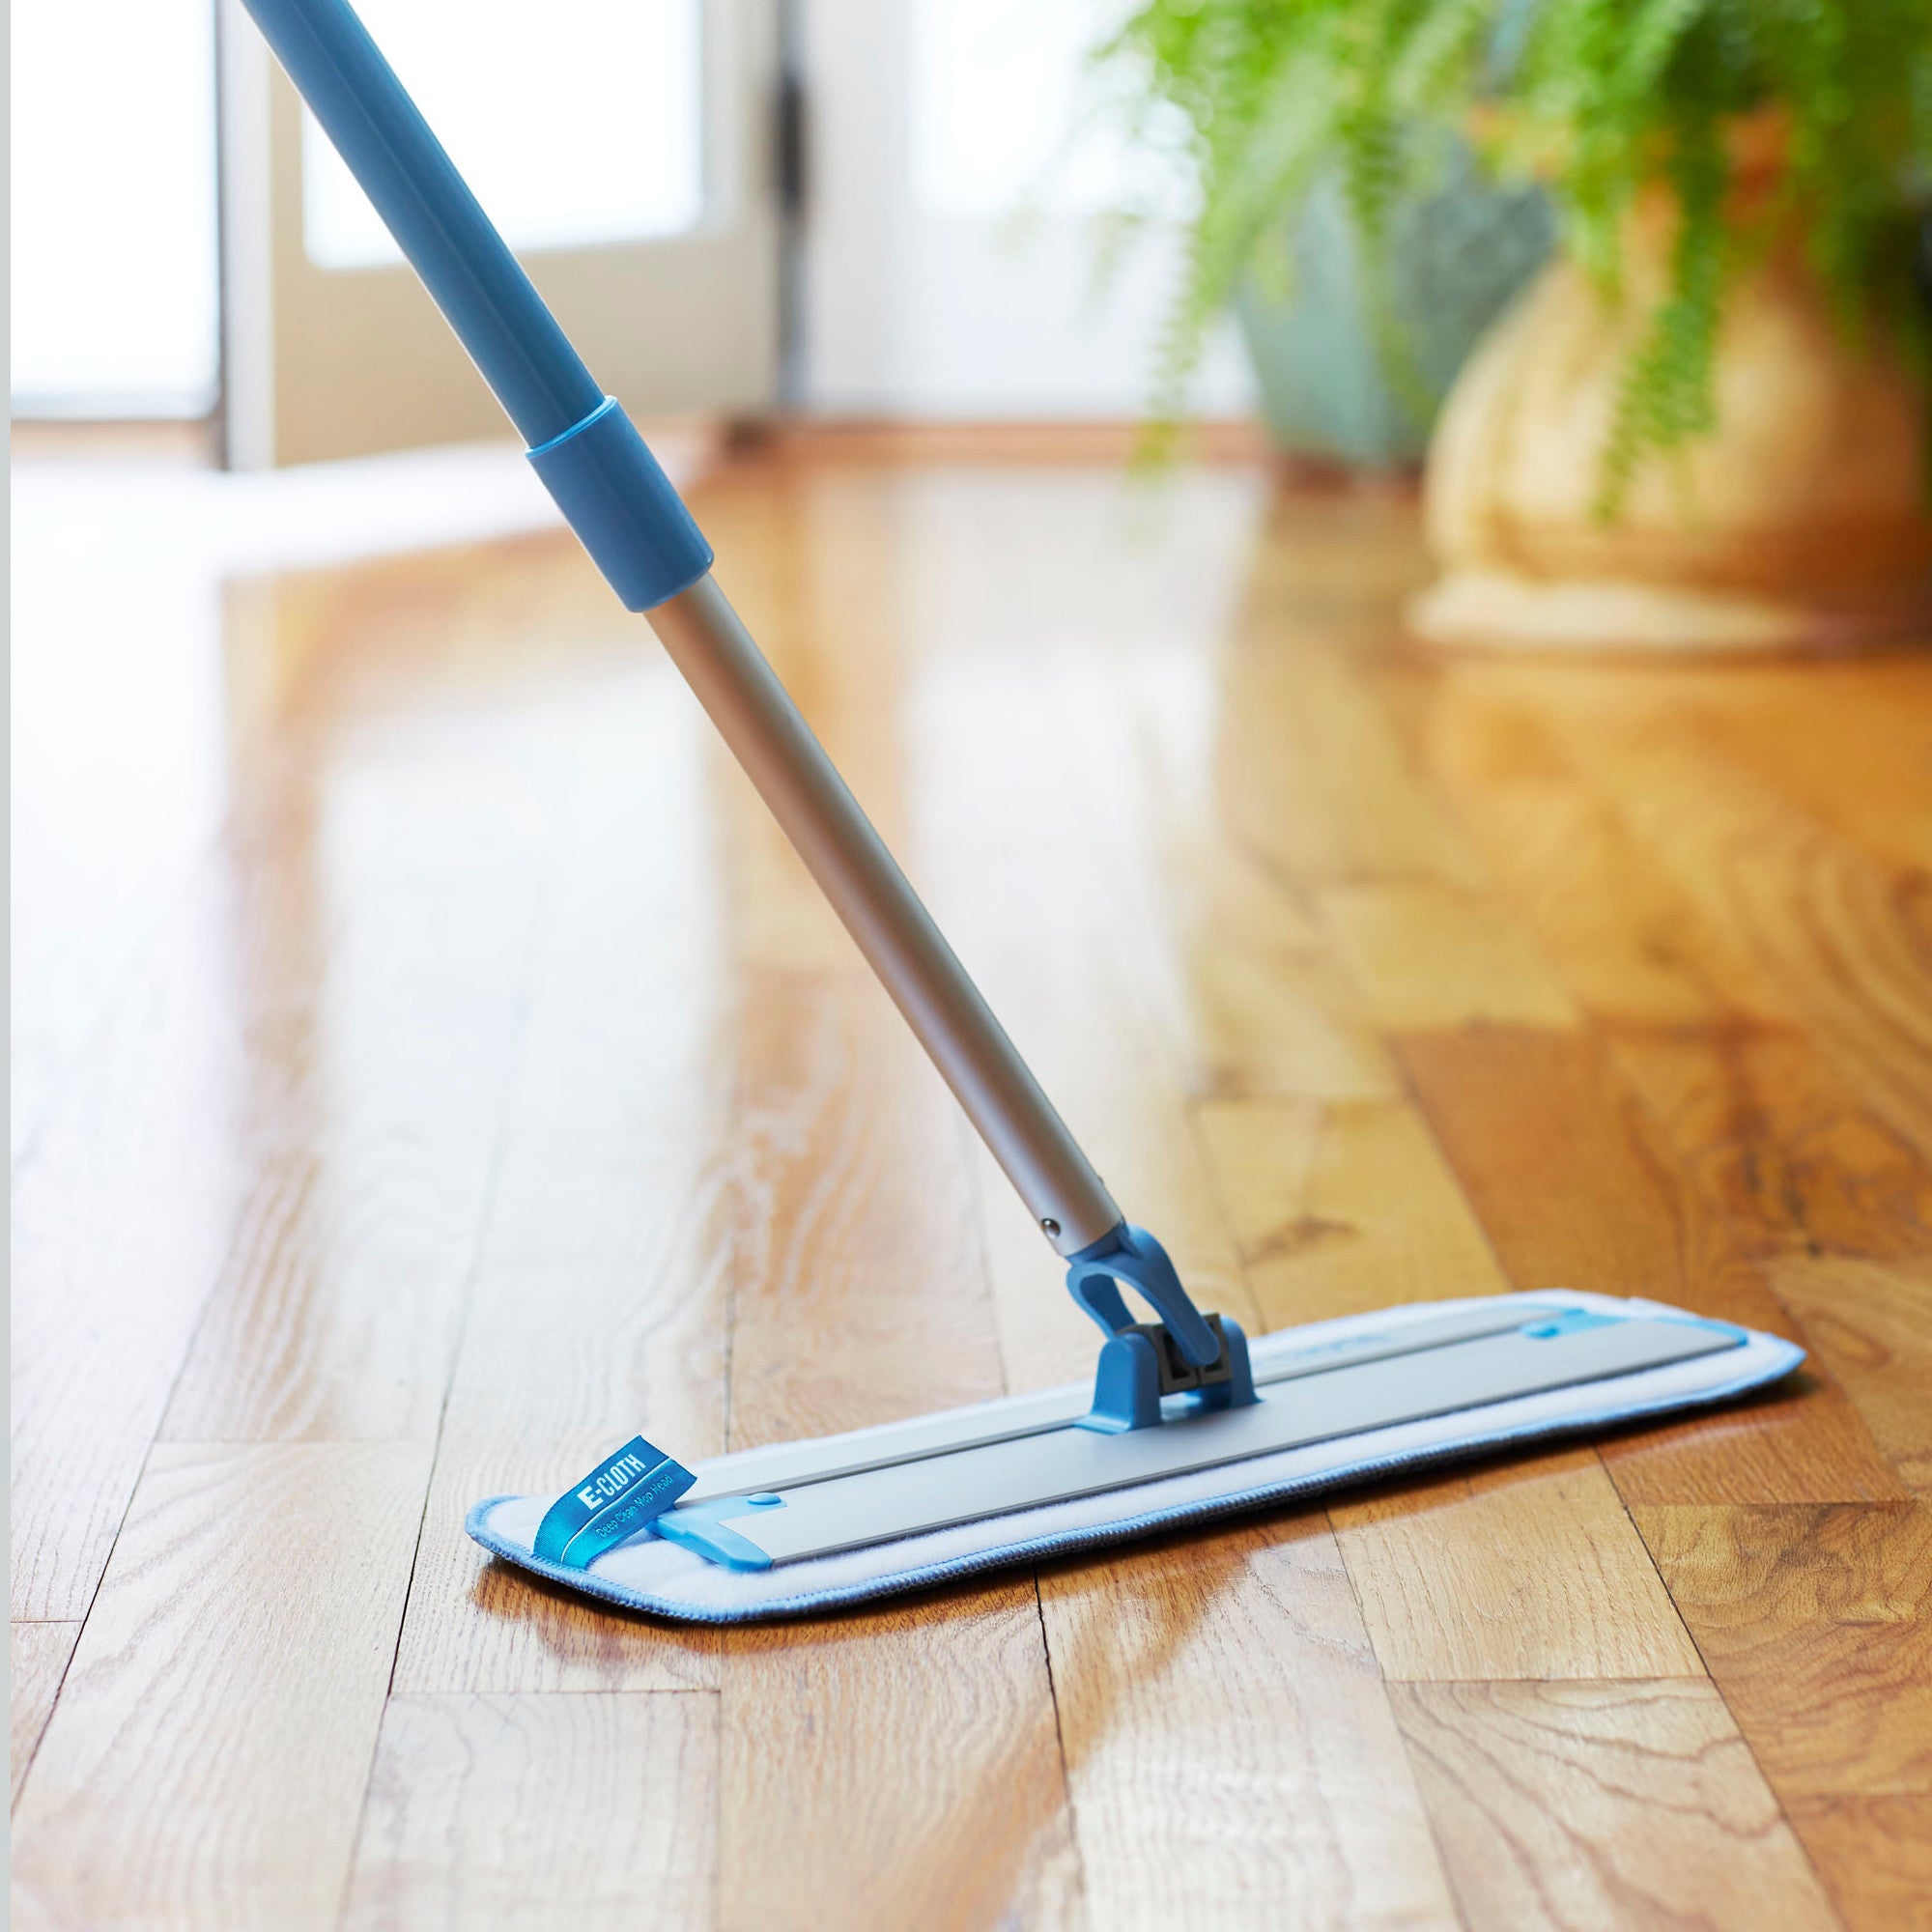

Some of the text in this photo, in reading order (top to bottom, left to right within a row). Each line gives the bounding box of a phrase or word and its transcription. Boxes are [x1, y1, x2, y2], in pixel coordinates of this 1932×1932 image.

[577, 1454, 646, 1510] E-CLOTH
[596, 1473, 674, 1538] Deep Clean Mop Head
